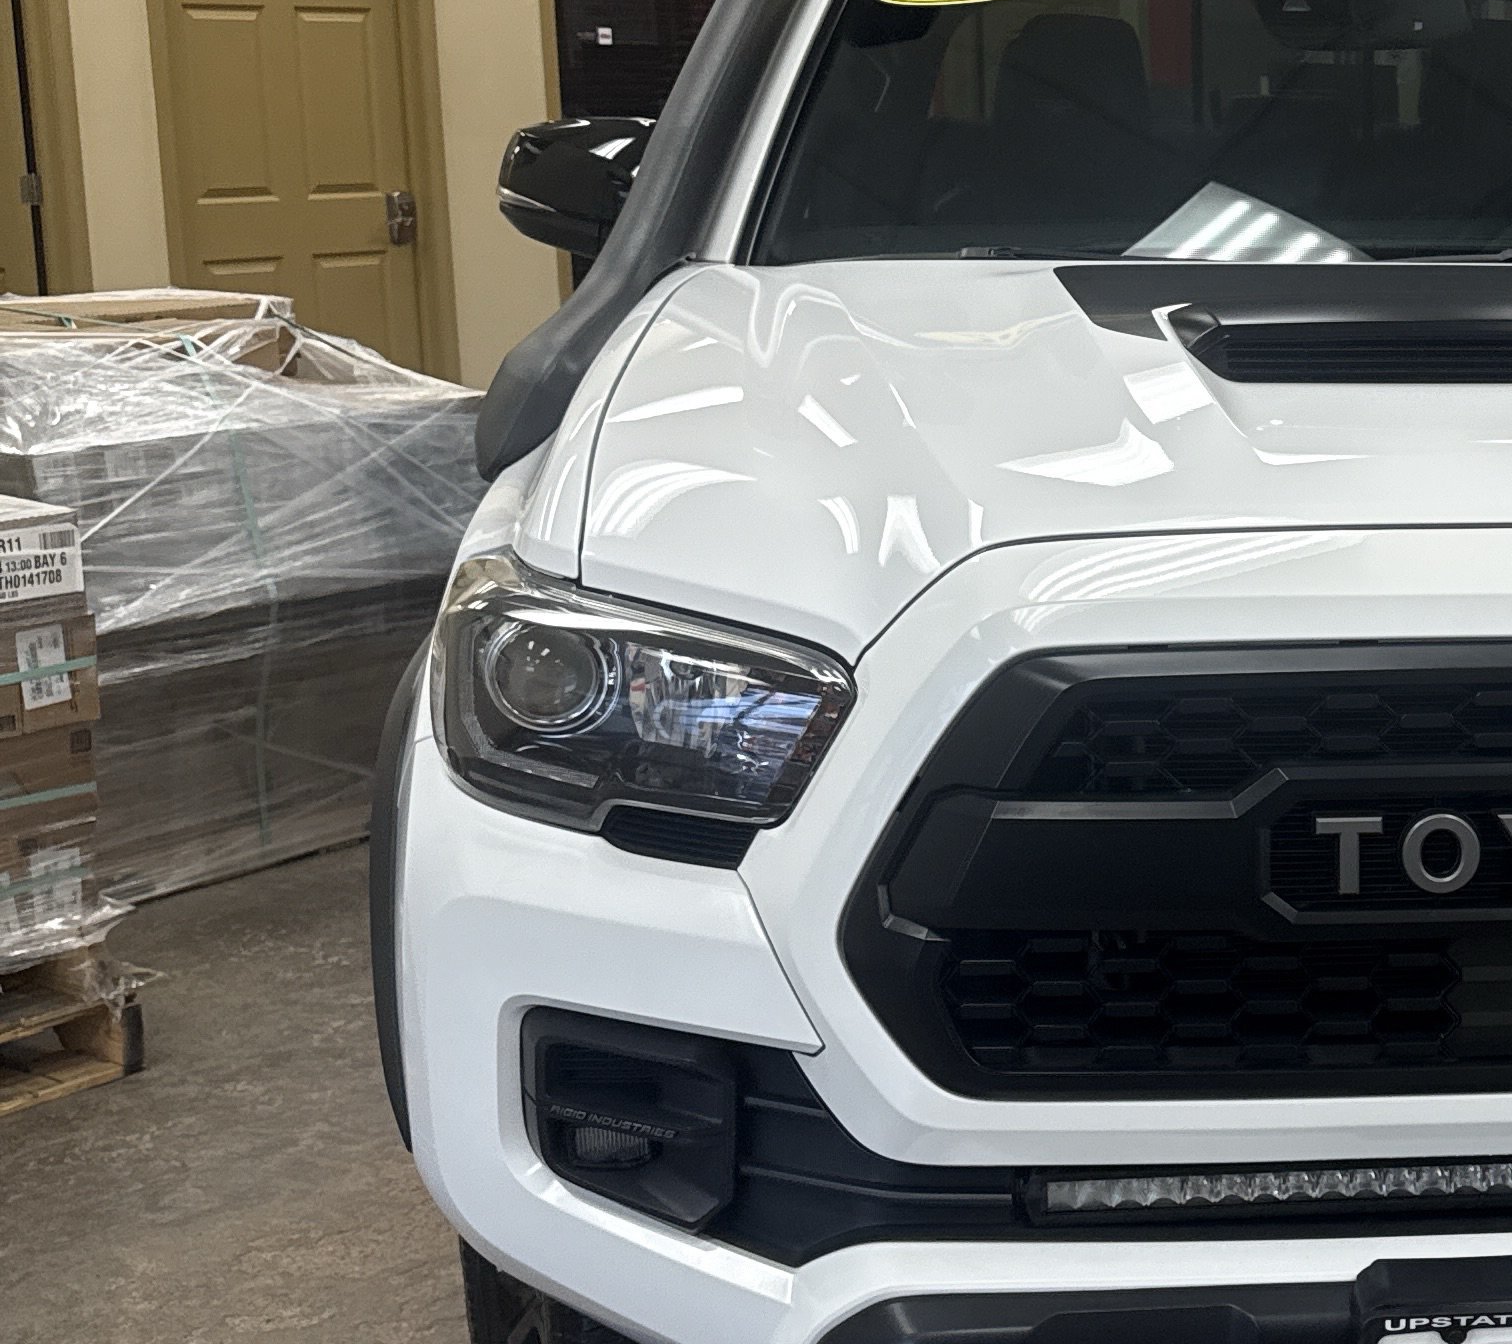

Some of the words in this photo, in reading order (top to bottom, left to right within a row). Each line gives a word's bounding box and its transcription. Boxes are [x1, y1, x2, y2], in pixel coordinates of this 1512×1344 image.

[5, 558, 32, 573] 13:00
[34, 553, 56, 569] BAY
[60, 551, 67, 566] 6
[550, 1105, 587, 1121] RIGID
[587, 1113, 676, 1138] INDUSTRIES
